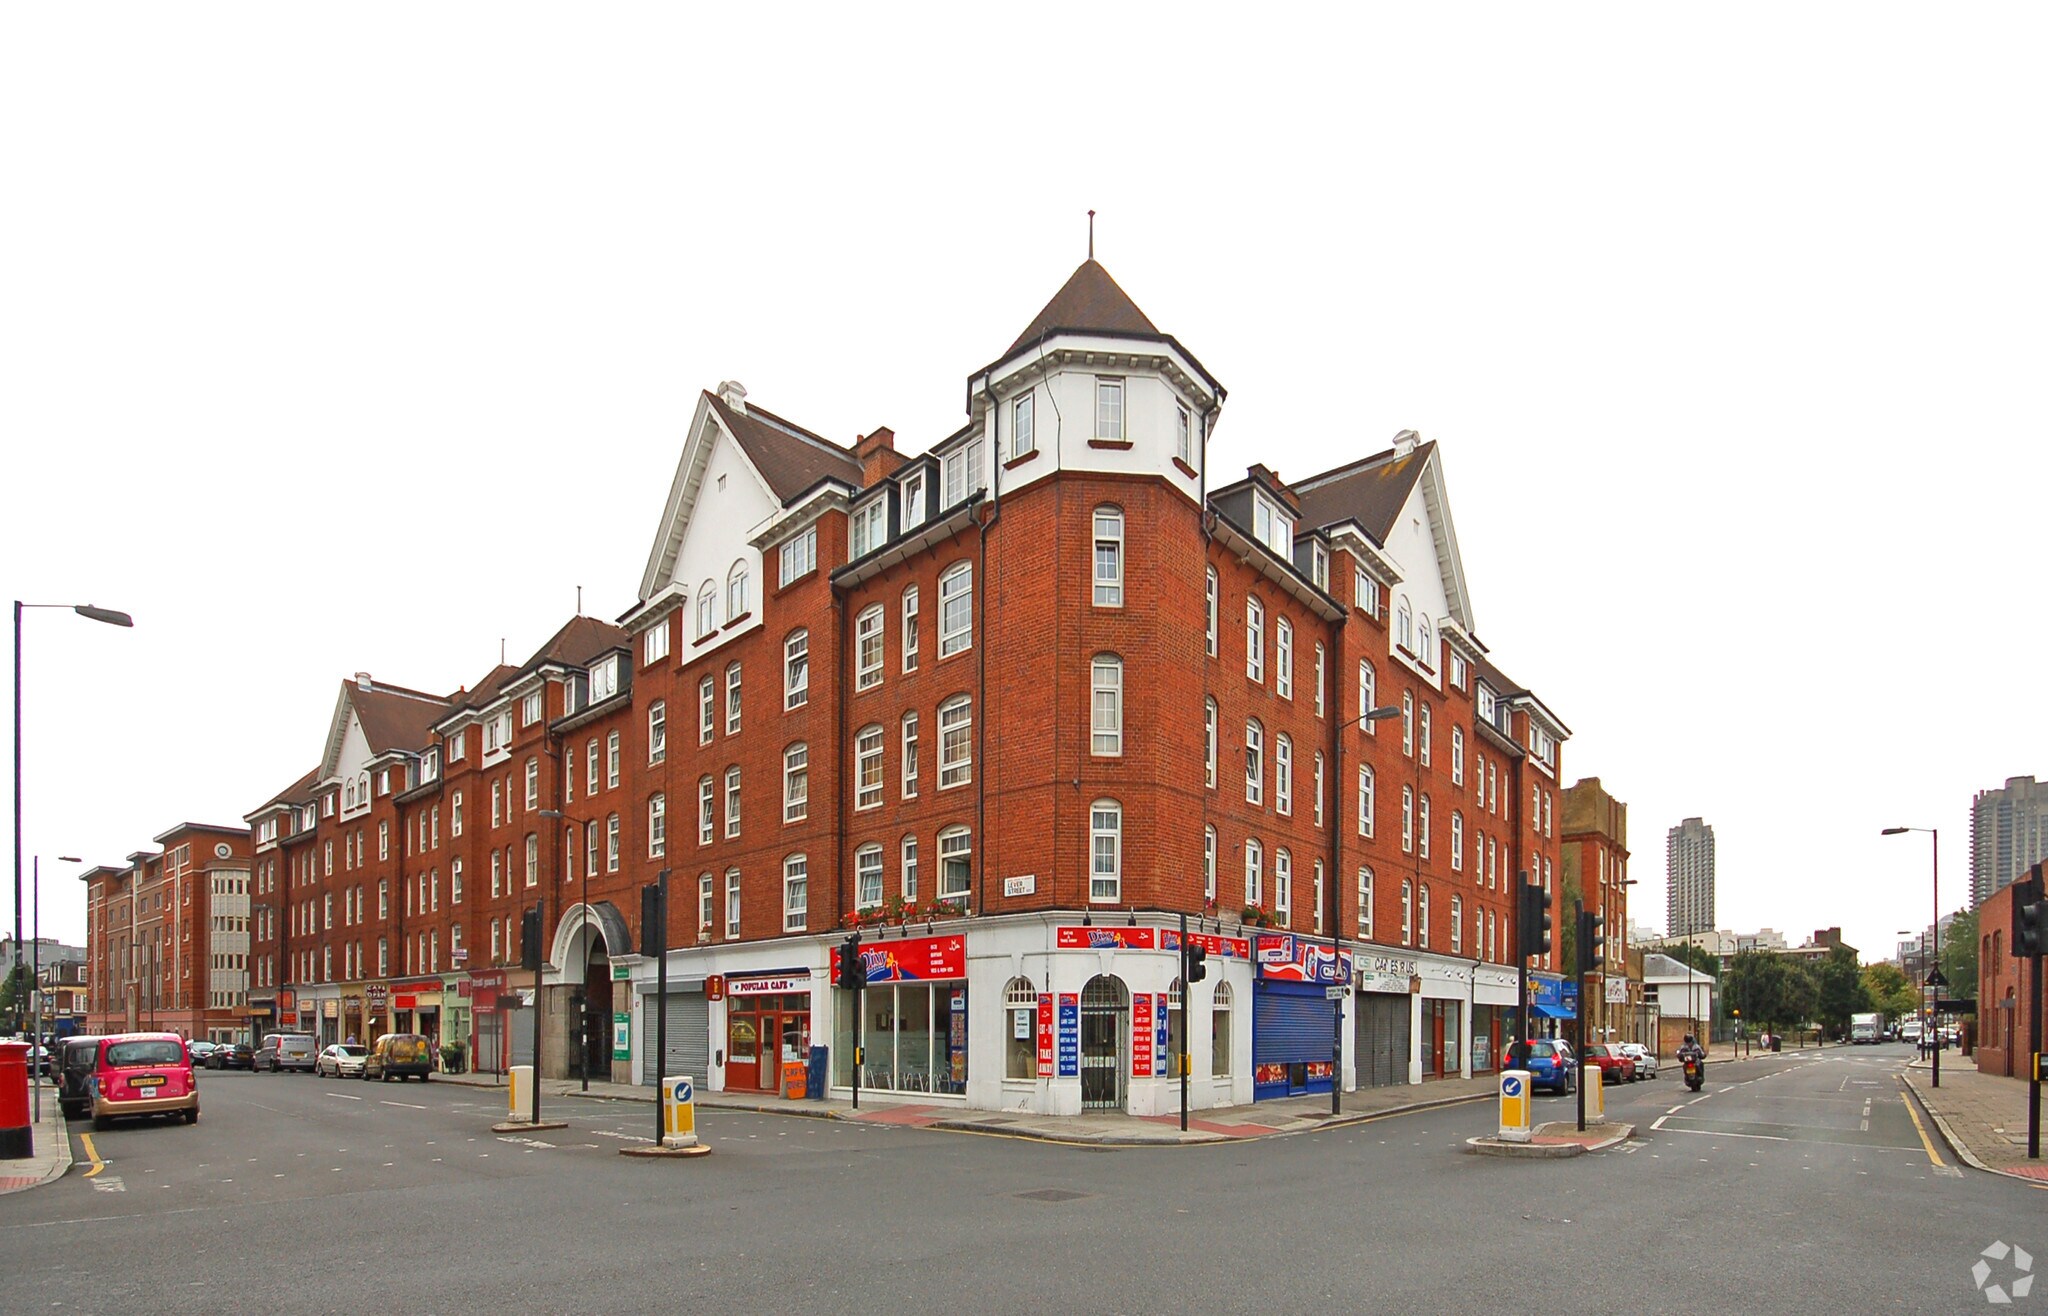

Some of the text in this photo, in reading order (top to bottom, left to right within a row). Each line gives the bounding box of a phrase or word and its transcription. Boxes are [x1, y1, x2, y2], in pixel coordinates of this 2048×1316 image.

[1007, 887, 1026, 895] STREET
[1406, 961, 1415, 974] US
[741, 981, 769, 991] POPULAR
[770, 980, 788, 990] CAFE
[1039, 1048, 1052, 1060] TAKE
